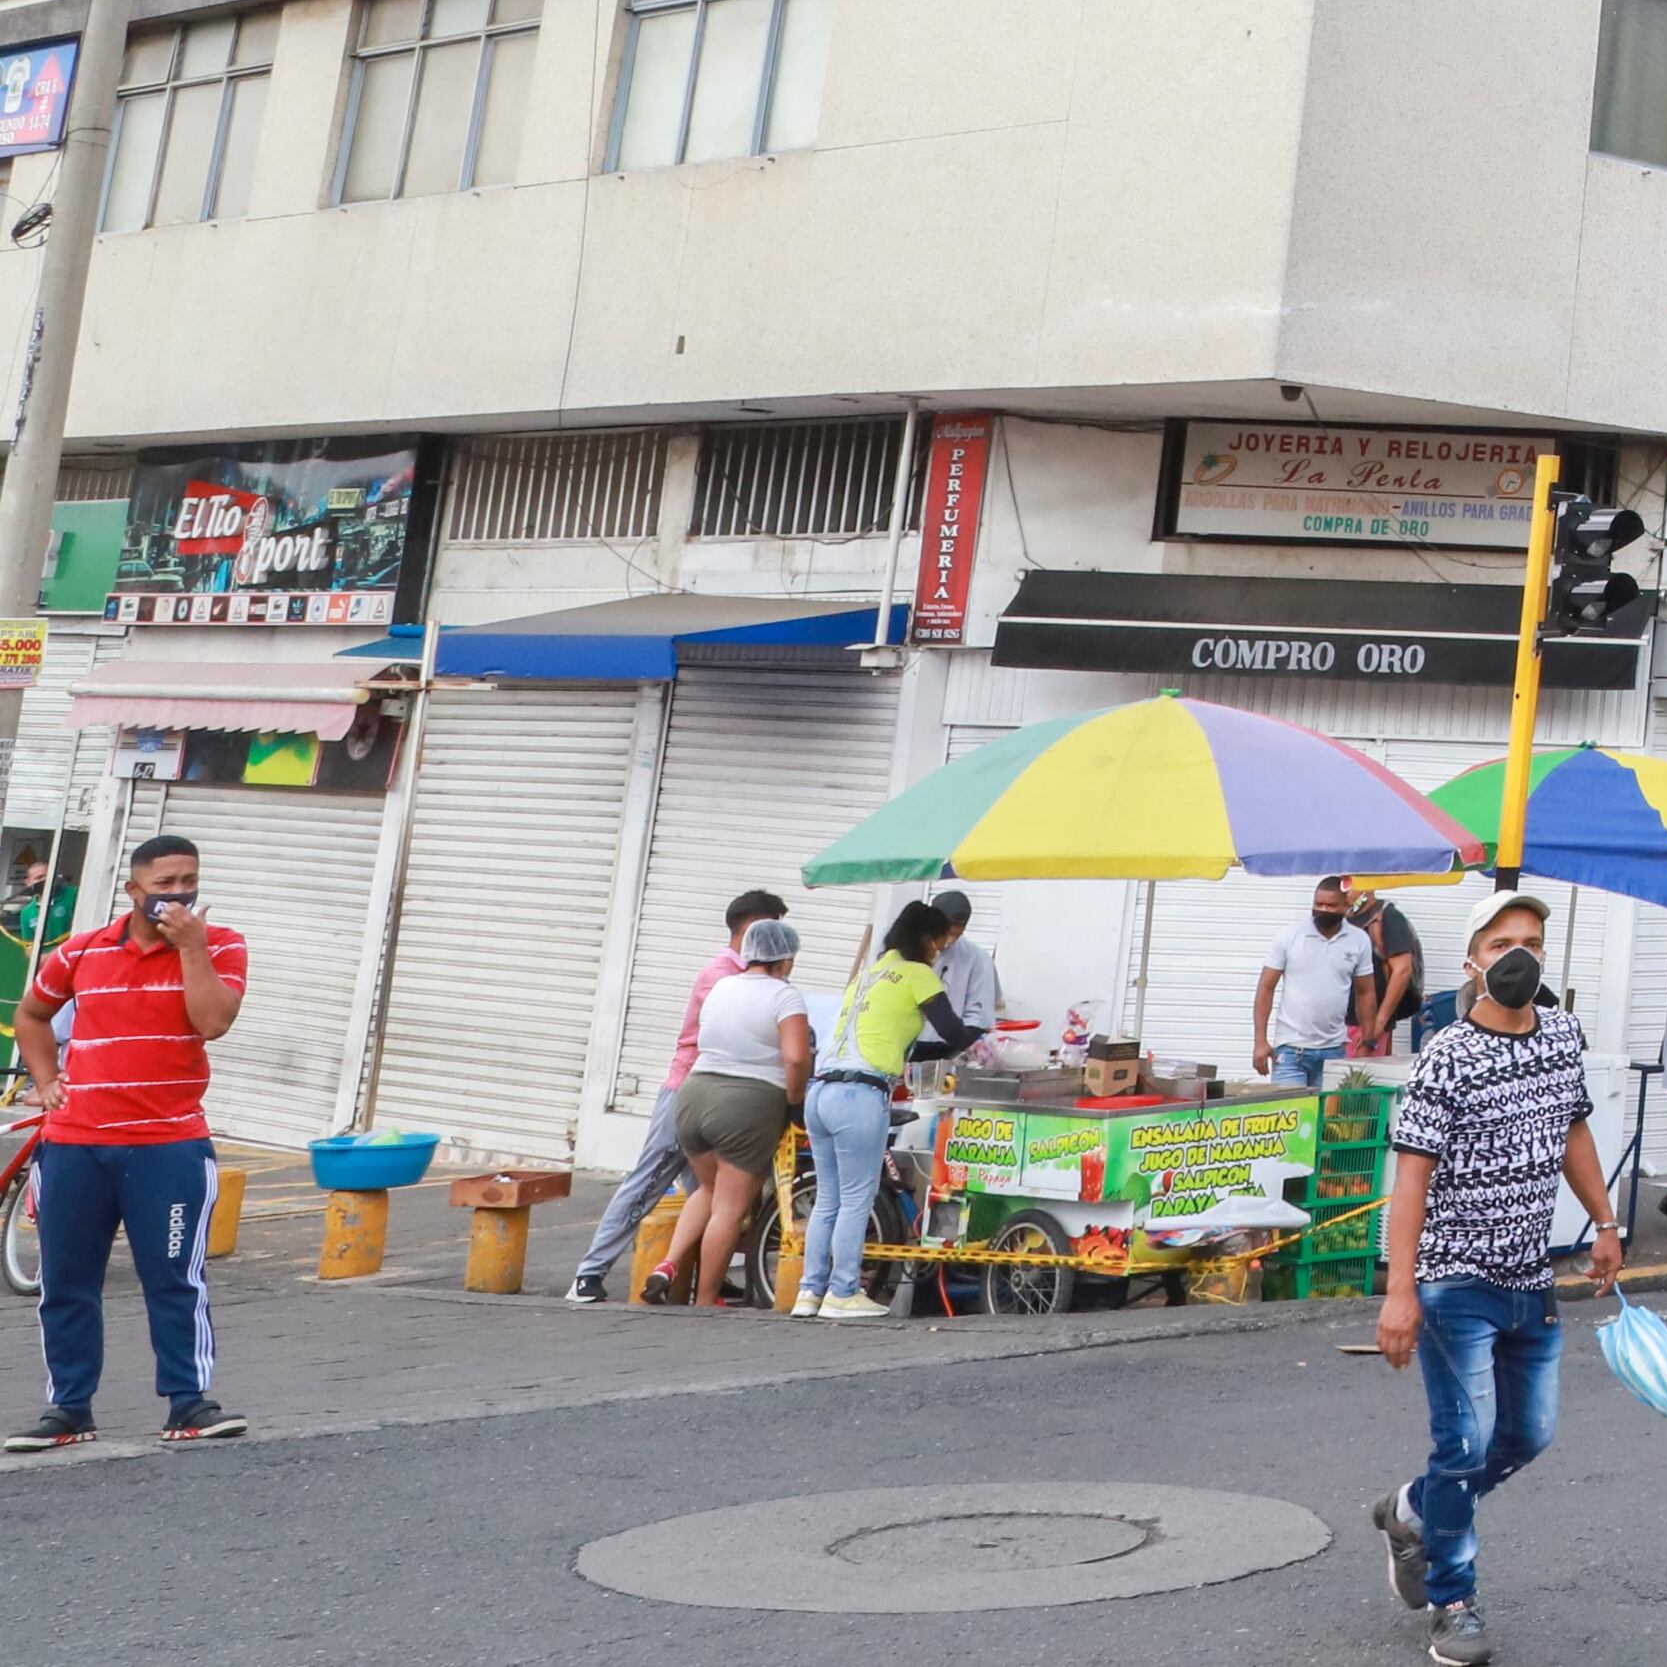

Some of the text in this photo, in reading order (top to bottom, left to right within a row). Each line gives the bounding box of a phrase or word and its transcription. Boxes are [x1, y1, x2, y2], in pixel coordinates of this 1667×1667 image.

[1228, 432, 1537, 465] JOYERIA Y RELOJERIA
[1274, 458, 1444, 490] La Perla
[174, 494, 242, 539] El Tio
[934, 449, 965, 598] PERFUMERIA
[1303, 515, 1429, 537] COMPRA DE ORO
[1462, 503, 1494, 520] PARA
[1192, 637, 1426, 674] COMPRO ORO
[954, 1117, 1015, 1142] JUGO DE
[1029, 1127, 1101, 1165] SALPICON
[1131, 1110, 1298, 1150] ENSALADA DE FRUTAS
[946, 1141, 1018, 1167] NARANJA
[1139, 1134, 1287, 1173] JUGO DE NARANJA
[1172, 1163, 1252, 1194] SALPICON
